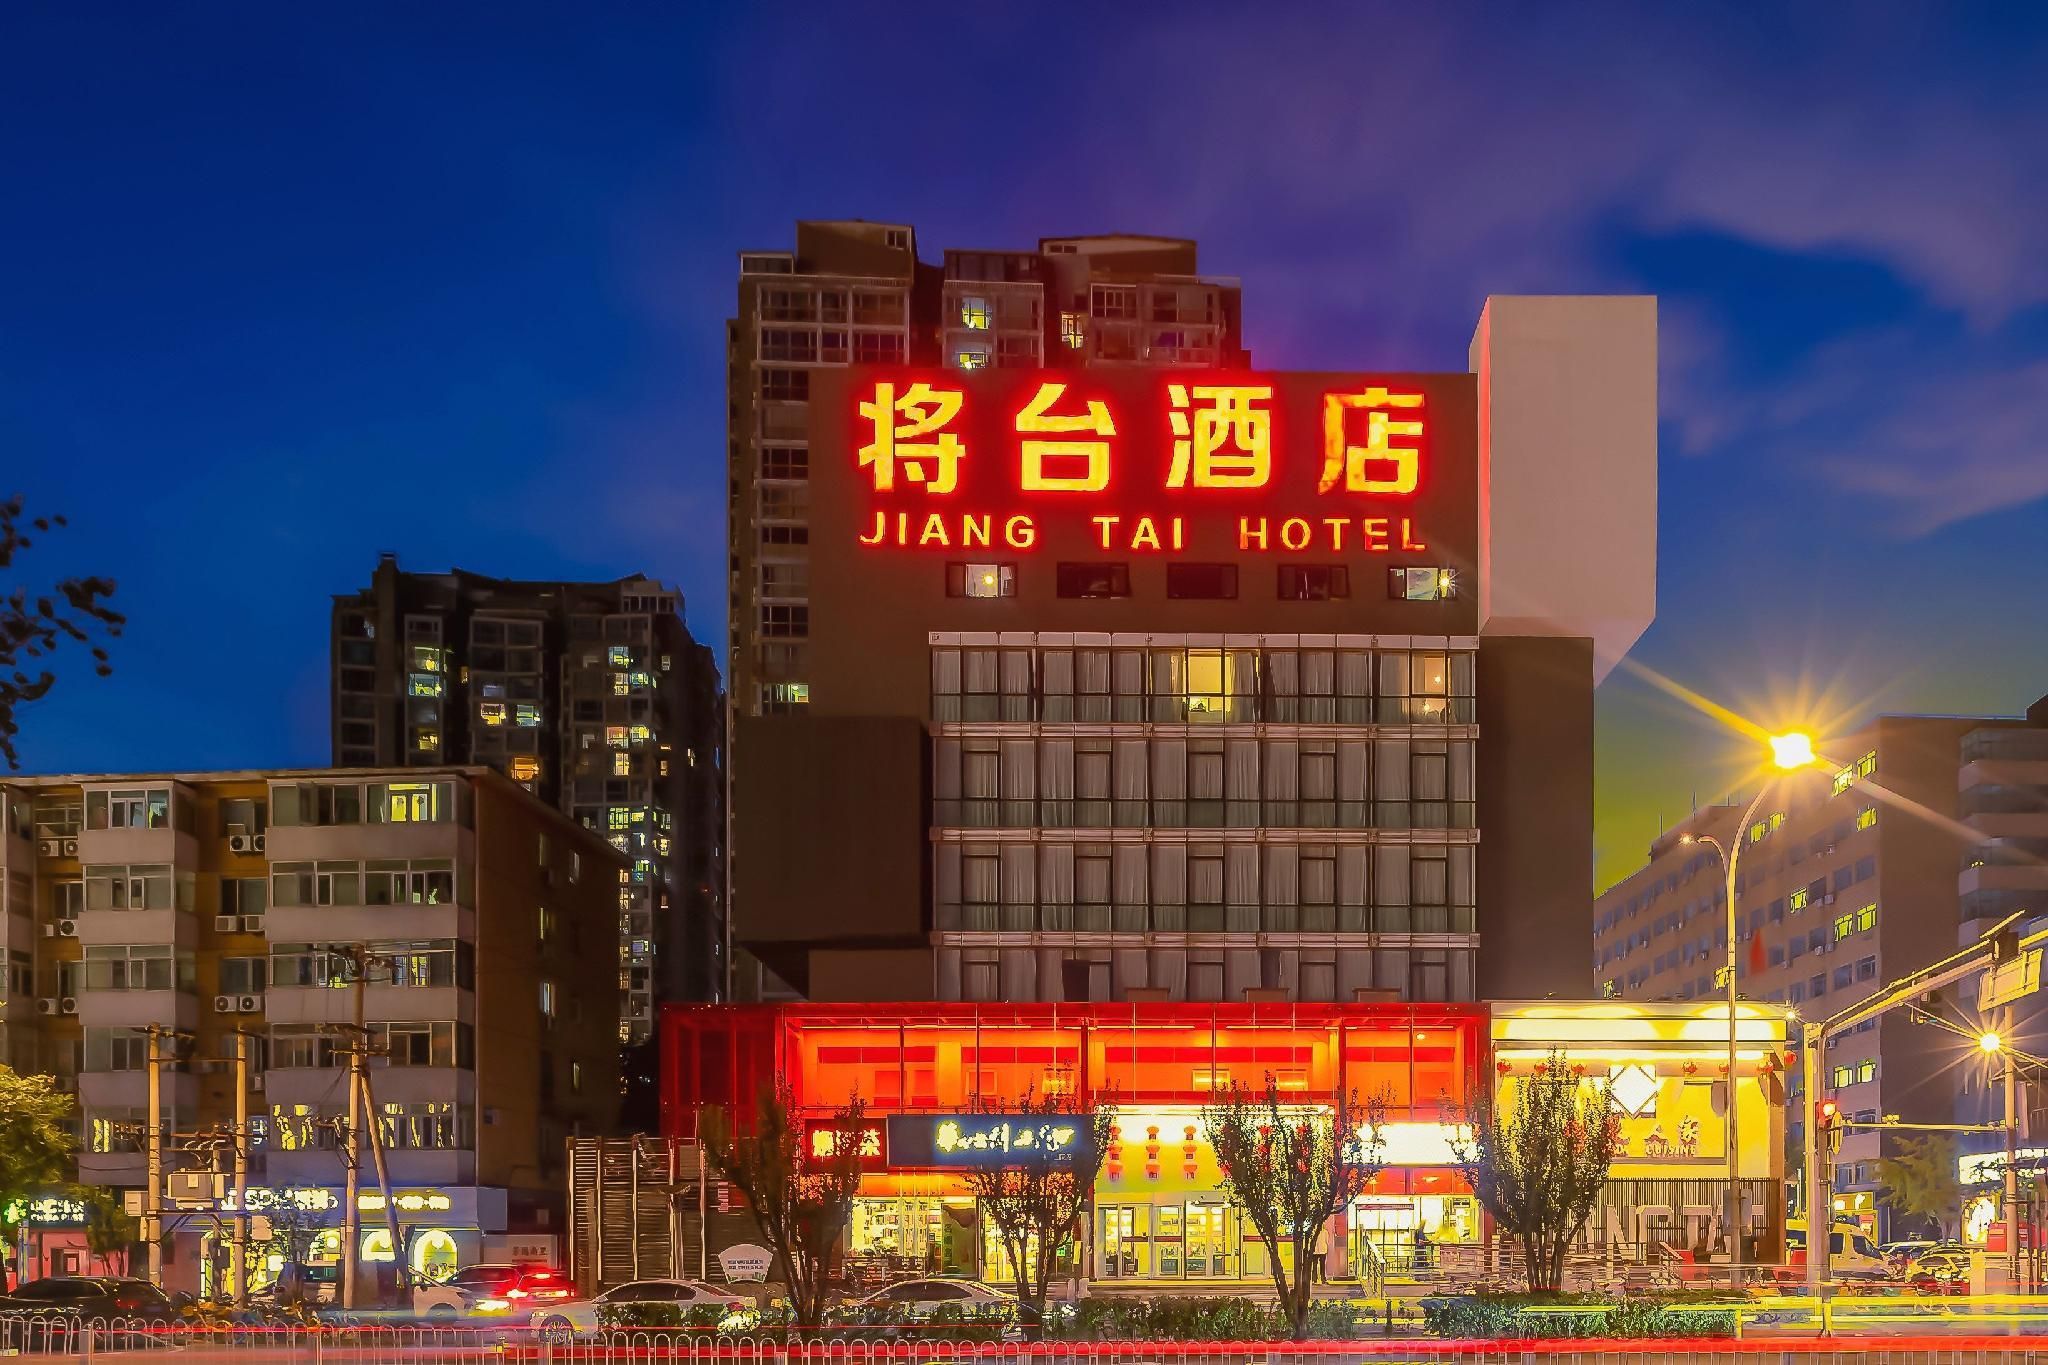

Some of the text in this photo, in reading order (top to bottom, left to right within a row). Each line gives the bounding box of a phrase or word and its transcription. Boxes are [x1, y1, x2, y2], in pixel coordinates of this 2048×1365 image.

[858, 382, 1425, 494] 将台酒店
[859, 511, 1426, 551] JIANG TAI HOTEL
